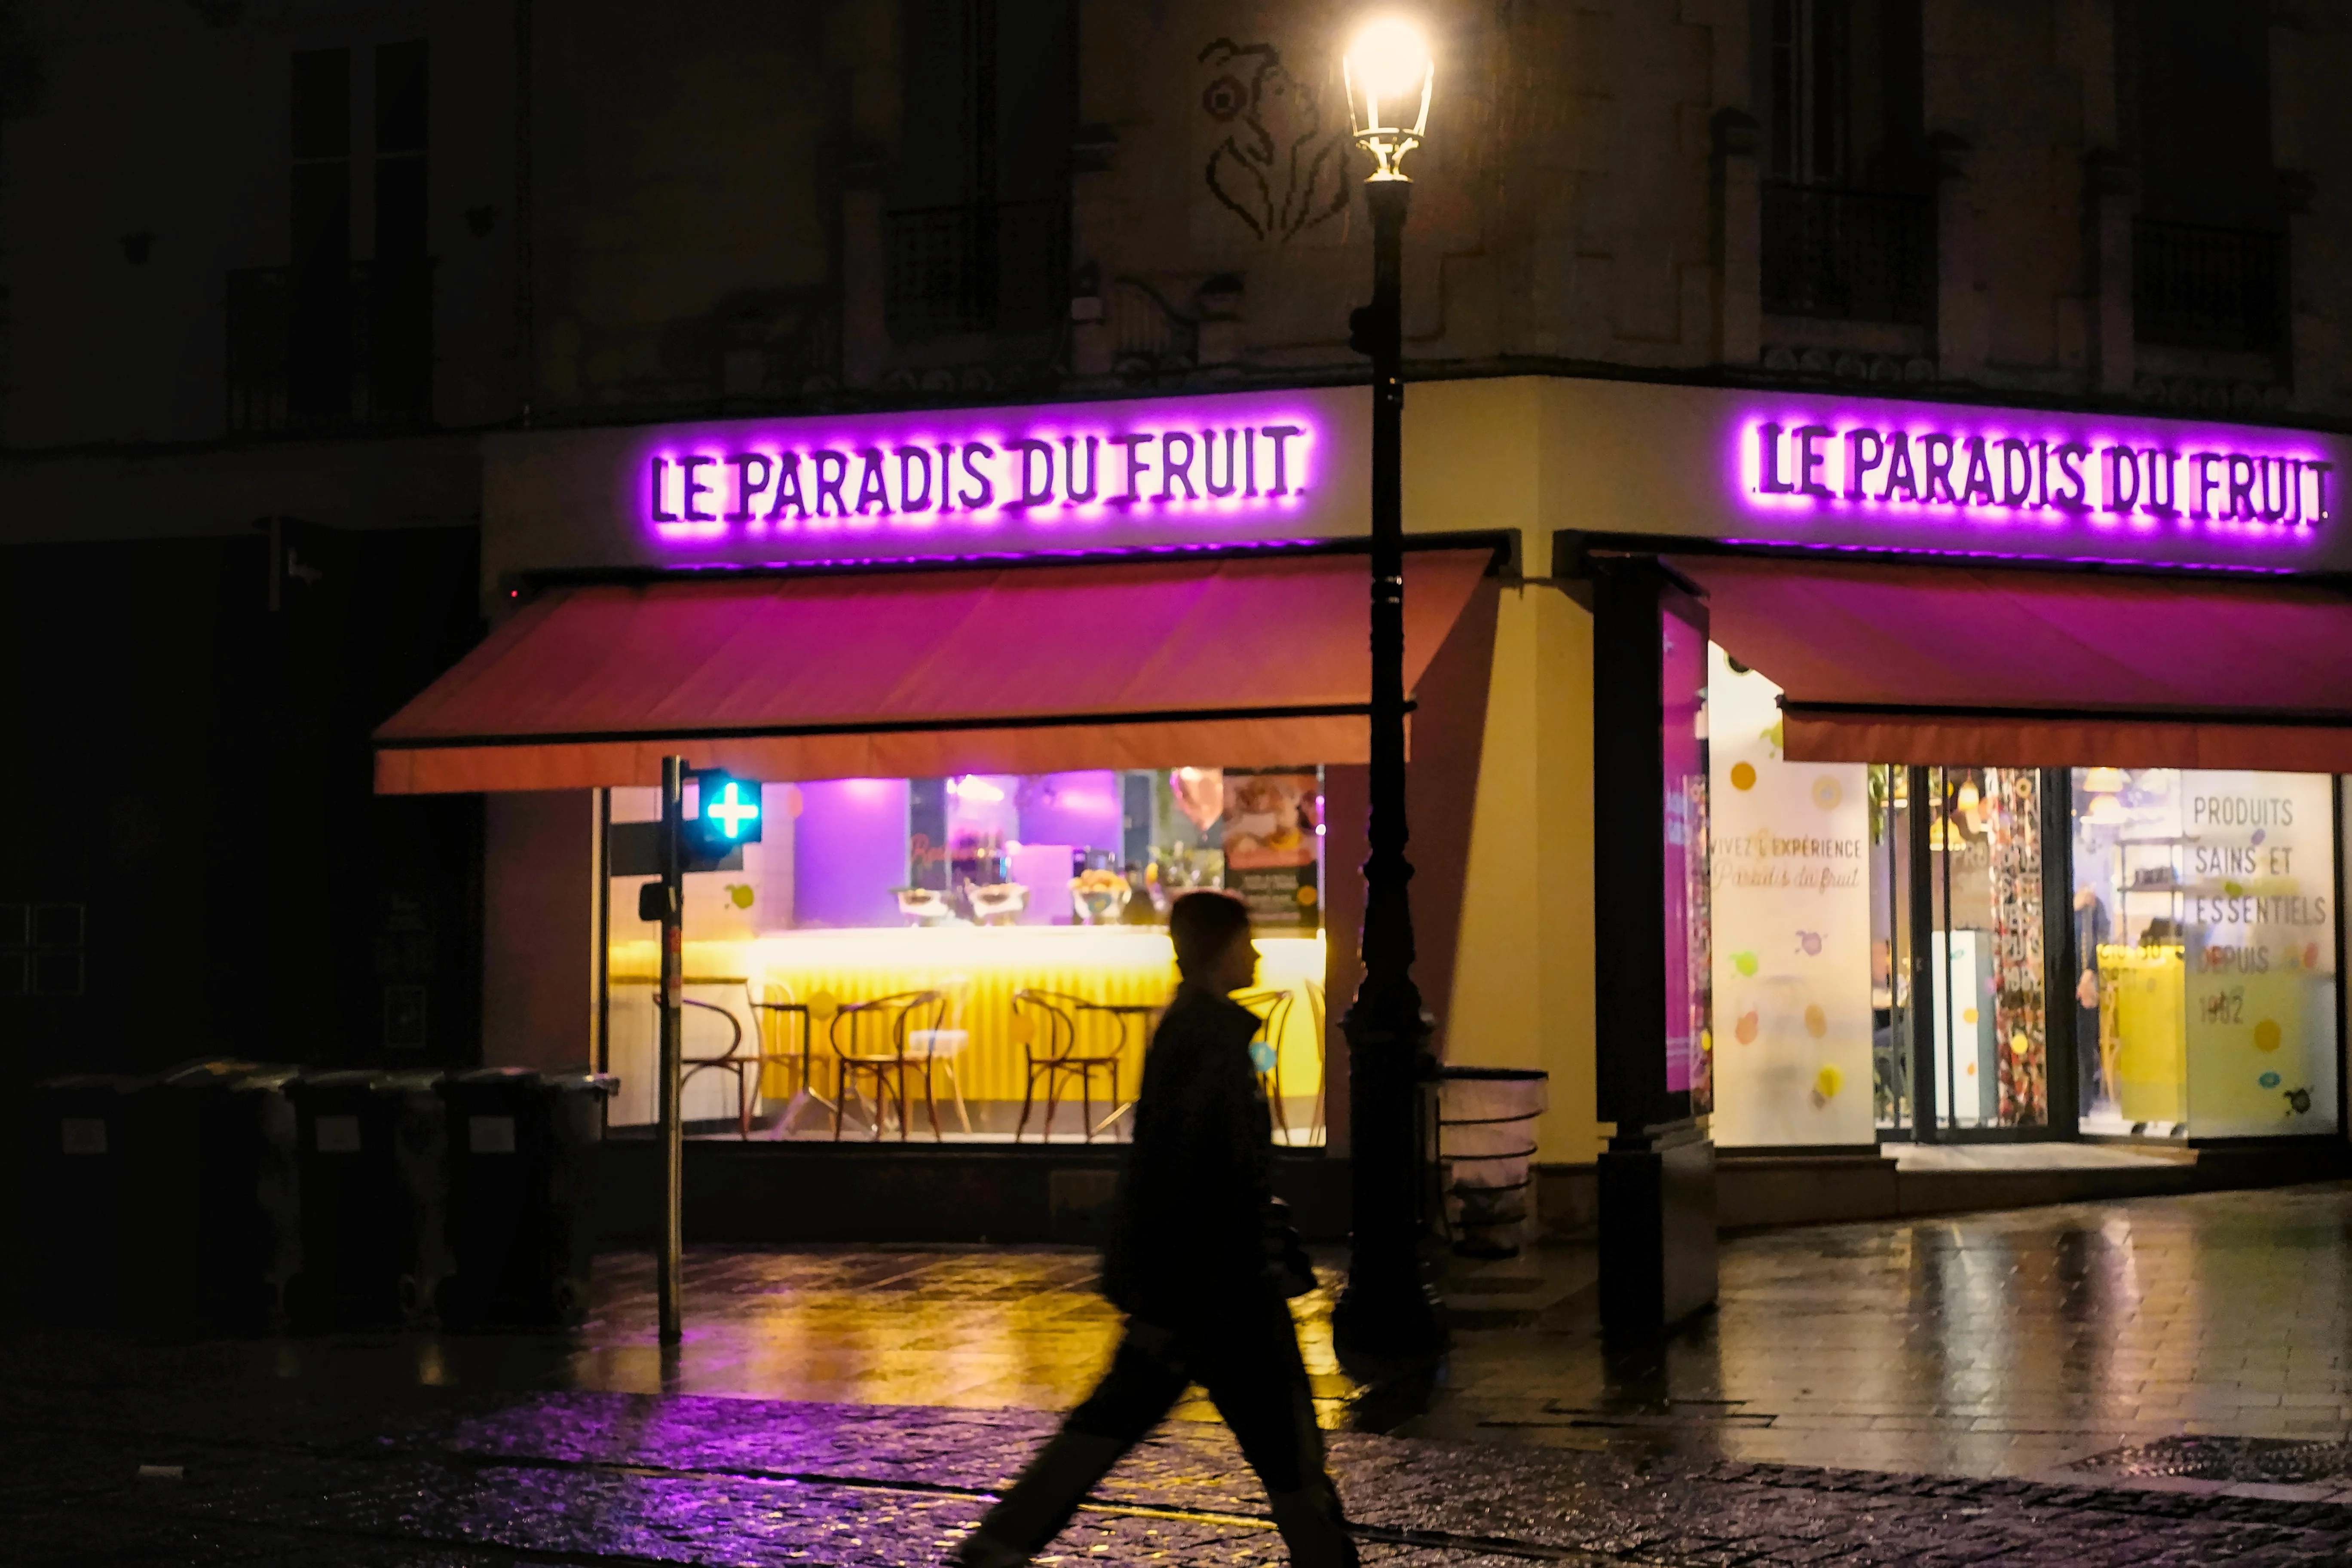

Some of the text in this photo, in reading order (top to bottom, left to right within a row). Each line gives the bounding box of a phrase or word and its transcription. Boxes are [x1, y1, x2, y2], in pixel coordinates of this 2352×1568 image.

[652, 425, 1301, 523] LE PARADIS DU FRUIT
[1761, 422, 2332, 525] LE PARADIS DU FRUIT
[2194, 796, 2293, 827] PRODUITS
[1709, 836, 1751, 857] VIVEZ
[2195, 845, 2293, 875] SAINS ET
[2196, 895, 2326, 925] ESSENTIELS
